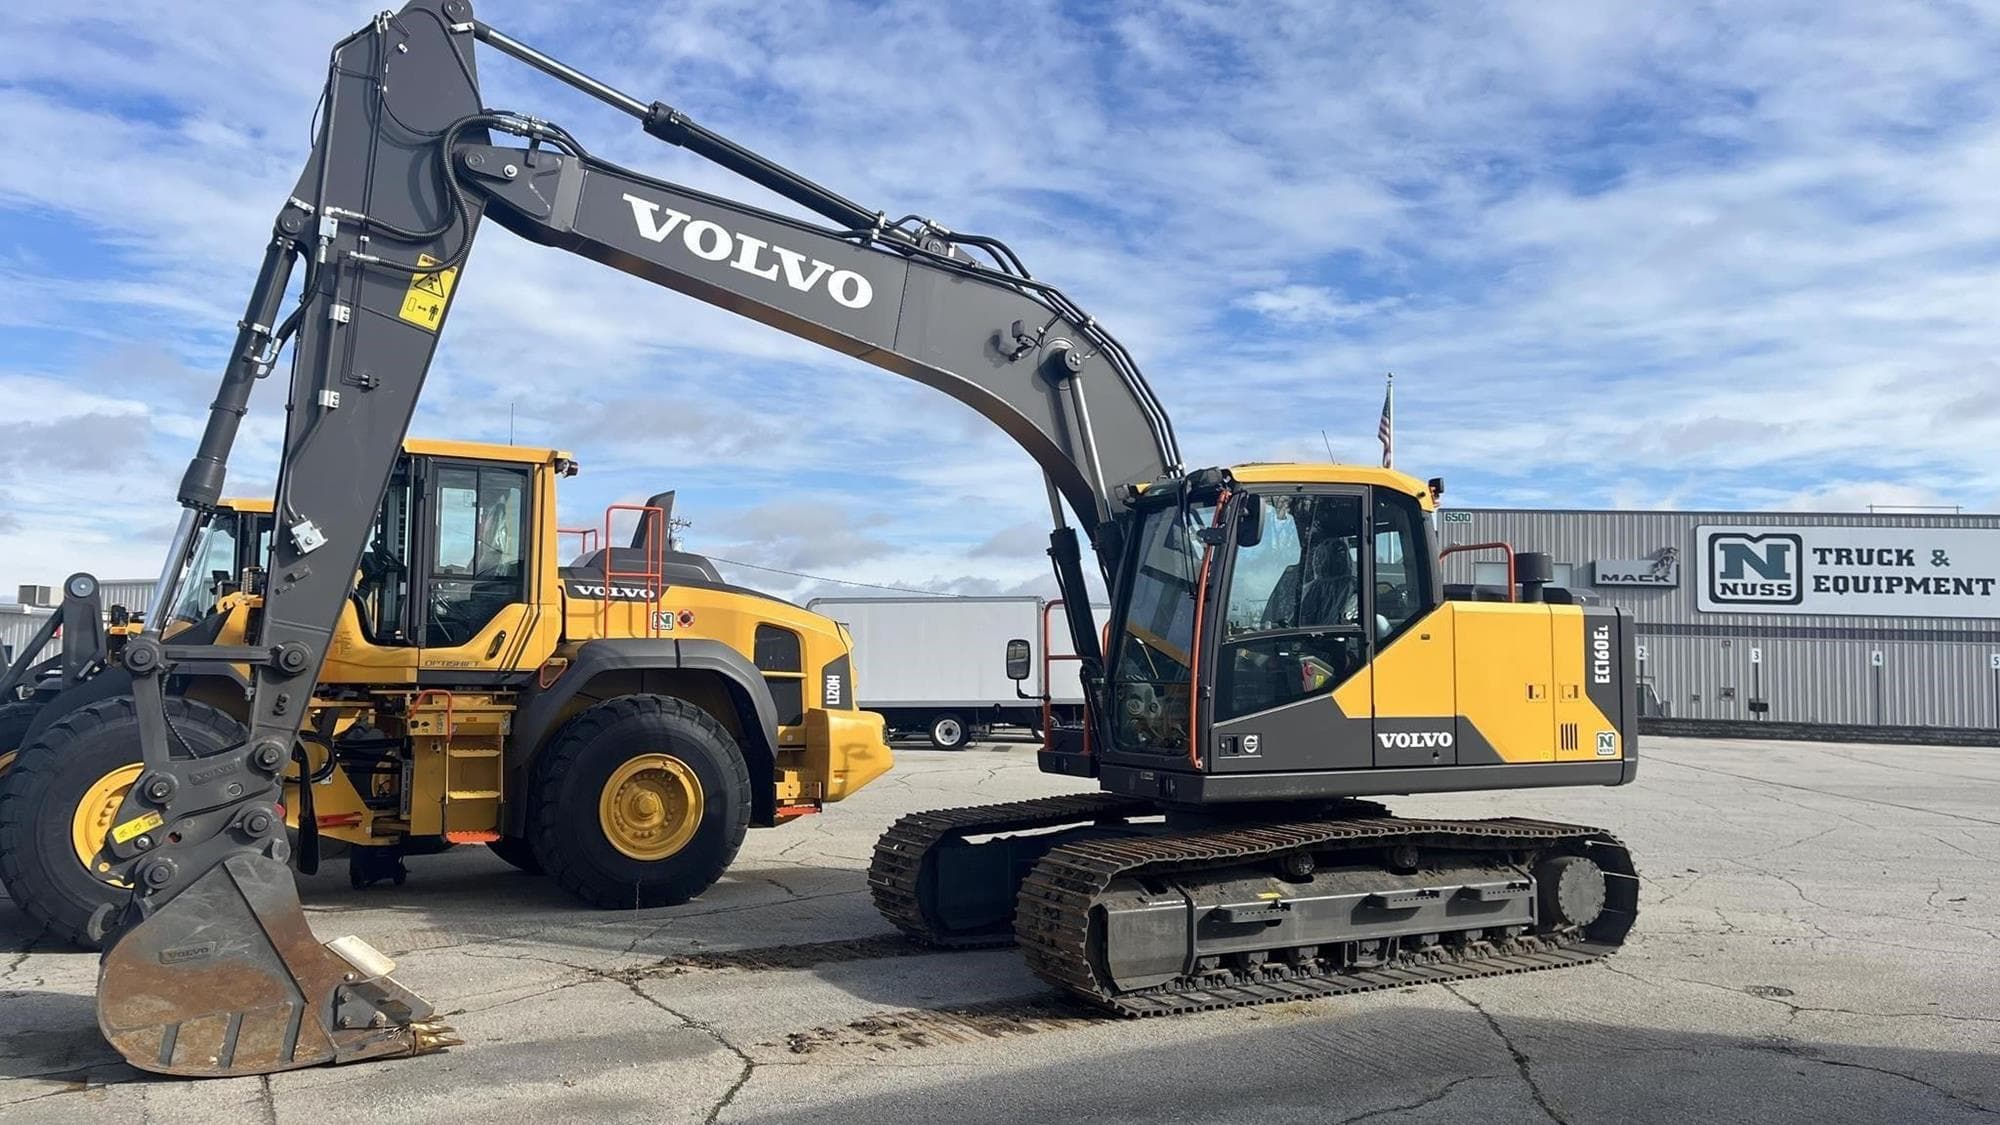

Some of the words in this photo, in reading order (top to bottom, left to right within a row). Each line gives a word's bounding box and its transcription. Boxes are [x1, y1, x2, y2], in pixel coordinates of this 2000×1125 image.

[622, 193, 873, 309] VOLVO
[1445, 512, 1472, 522] 6500
[1812, 548, 1915, 567] TRUCK
[1930, 549, 1951, 567] &
[1601, 574, 1670, 583] MACK
[1812, 574, 1995, 597] EQUIPMENT
[574, 585, 655, 598] VOLVO
[1719, 582, 1792, 597] NUSS
[1639, 648, 1645, 657] 2
[1753, 651, 1759, 660] 3
[1874, 653, 1880, 663] 4
[826, 675, 840, 705] L120H
[1377, 732, 1453, 748] VOLVO
